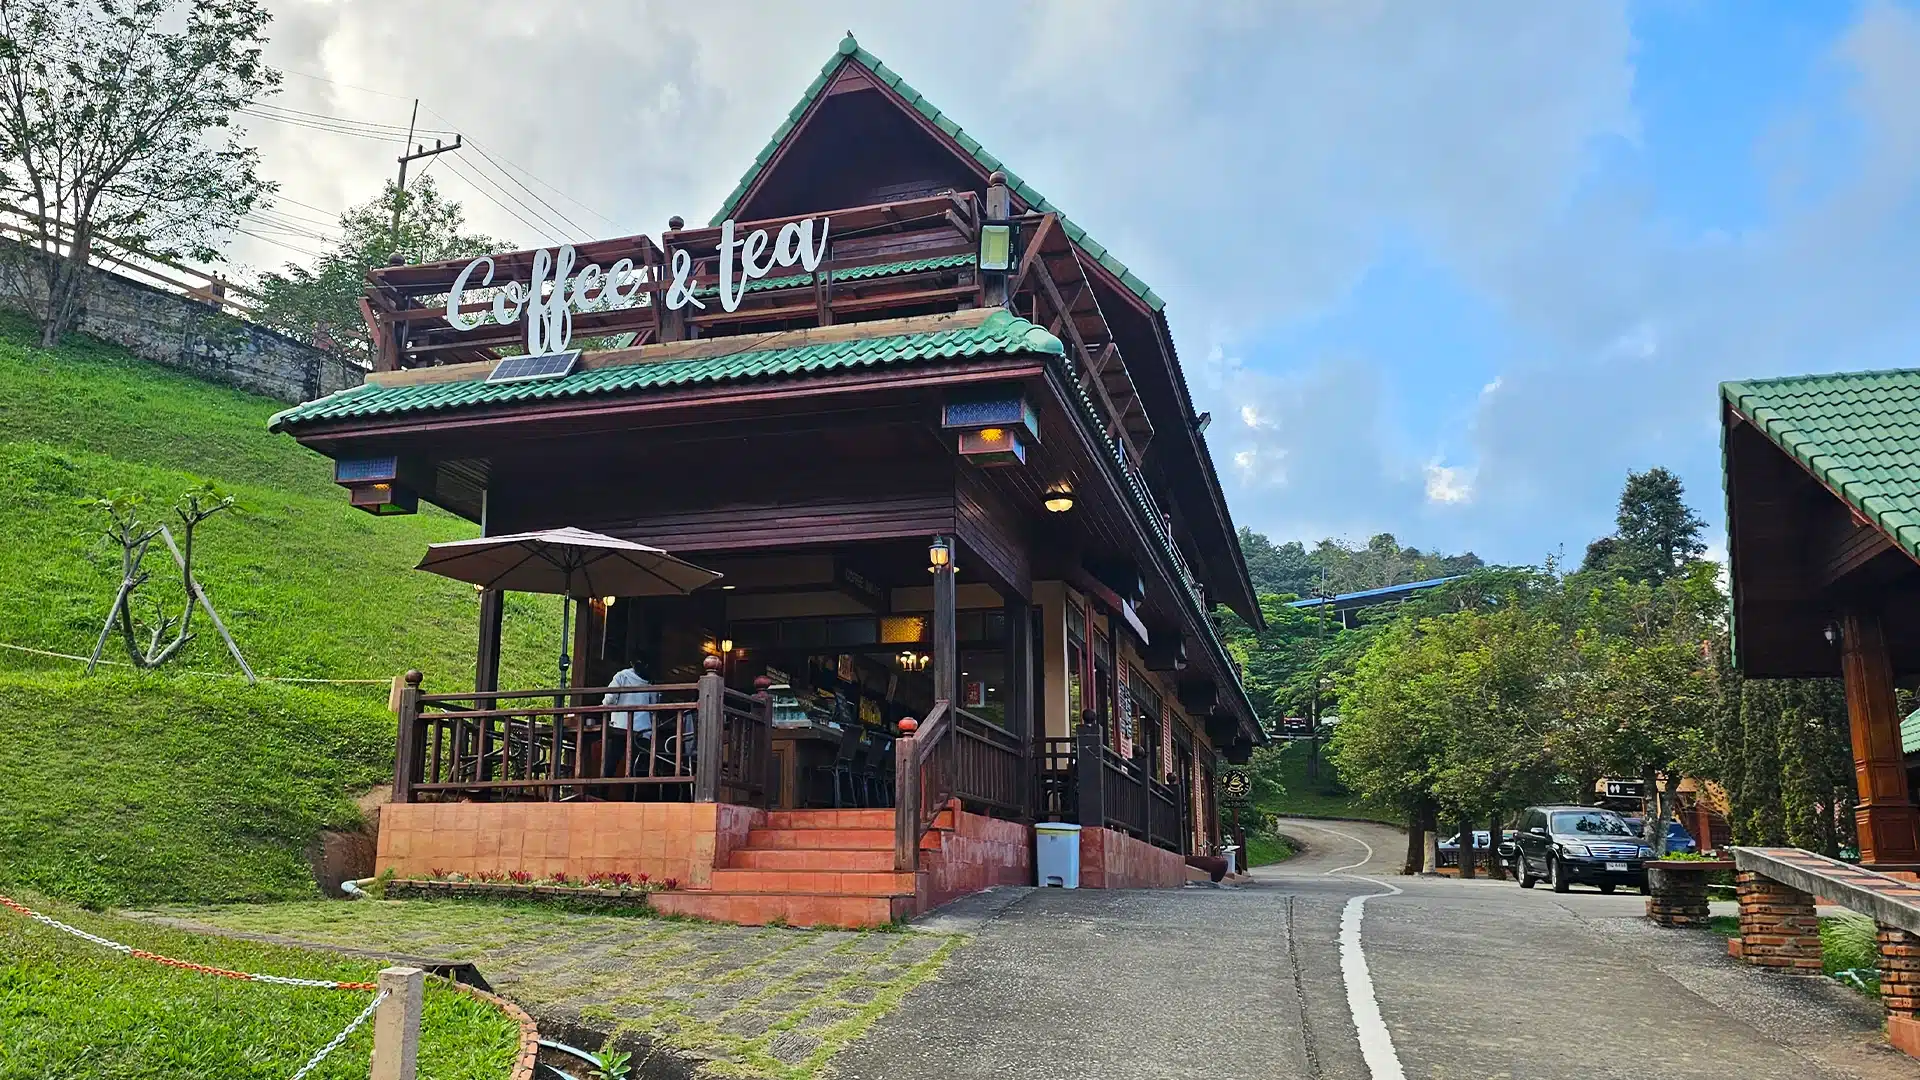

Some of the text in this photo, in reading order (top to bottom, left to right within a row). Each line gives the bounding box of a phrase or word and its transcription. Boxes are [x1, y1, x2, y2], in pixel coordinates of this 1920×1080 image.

[447, 217, 829, 356] Coffee & tea
